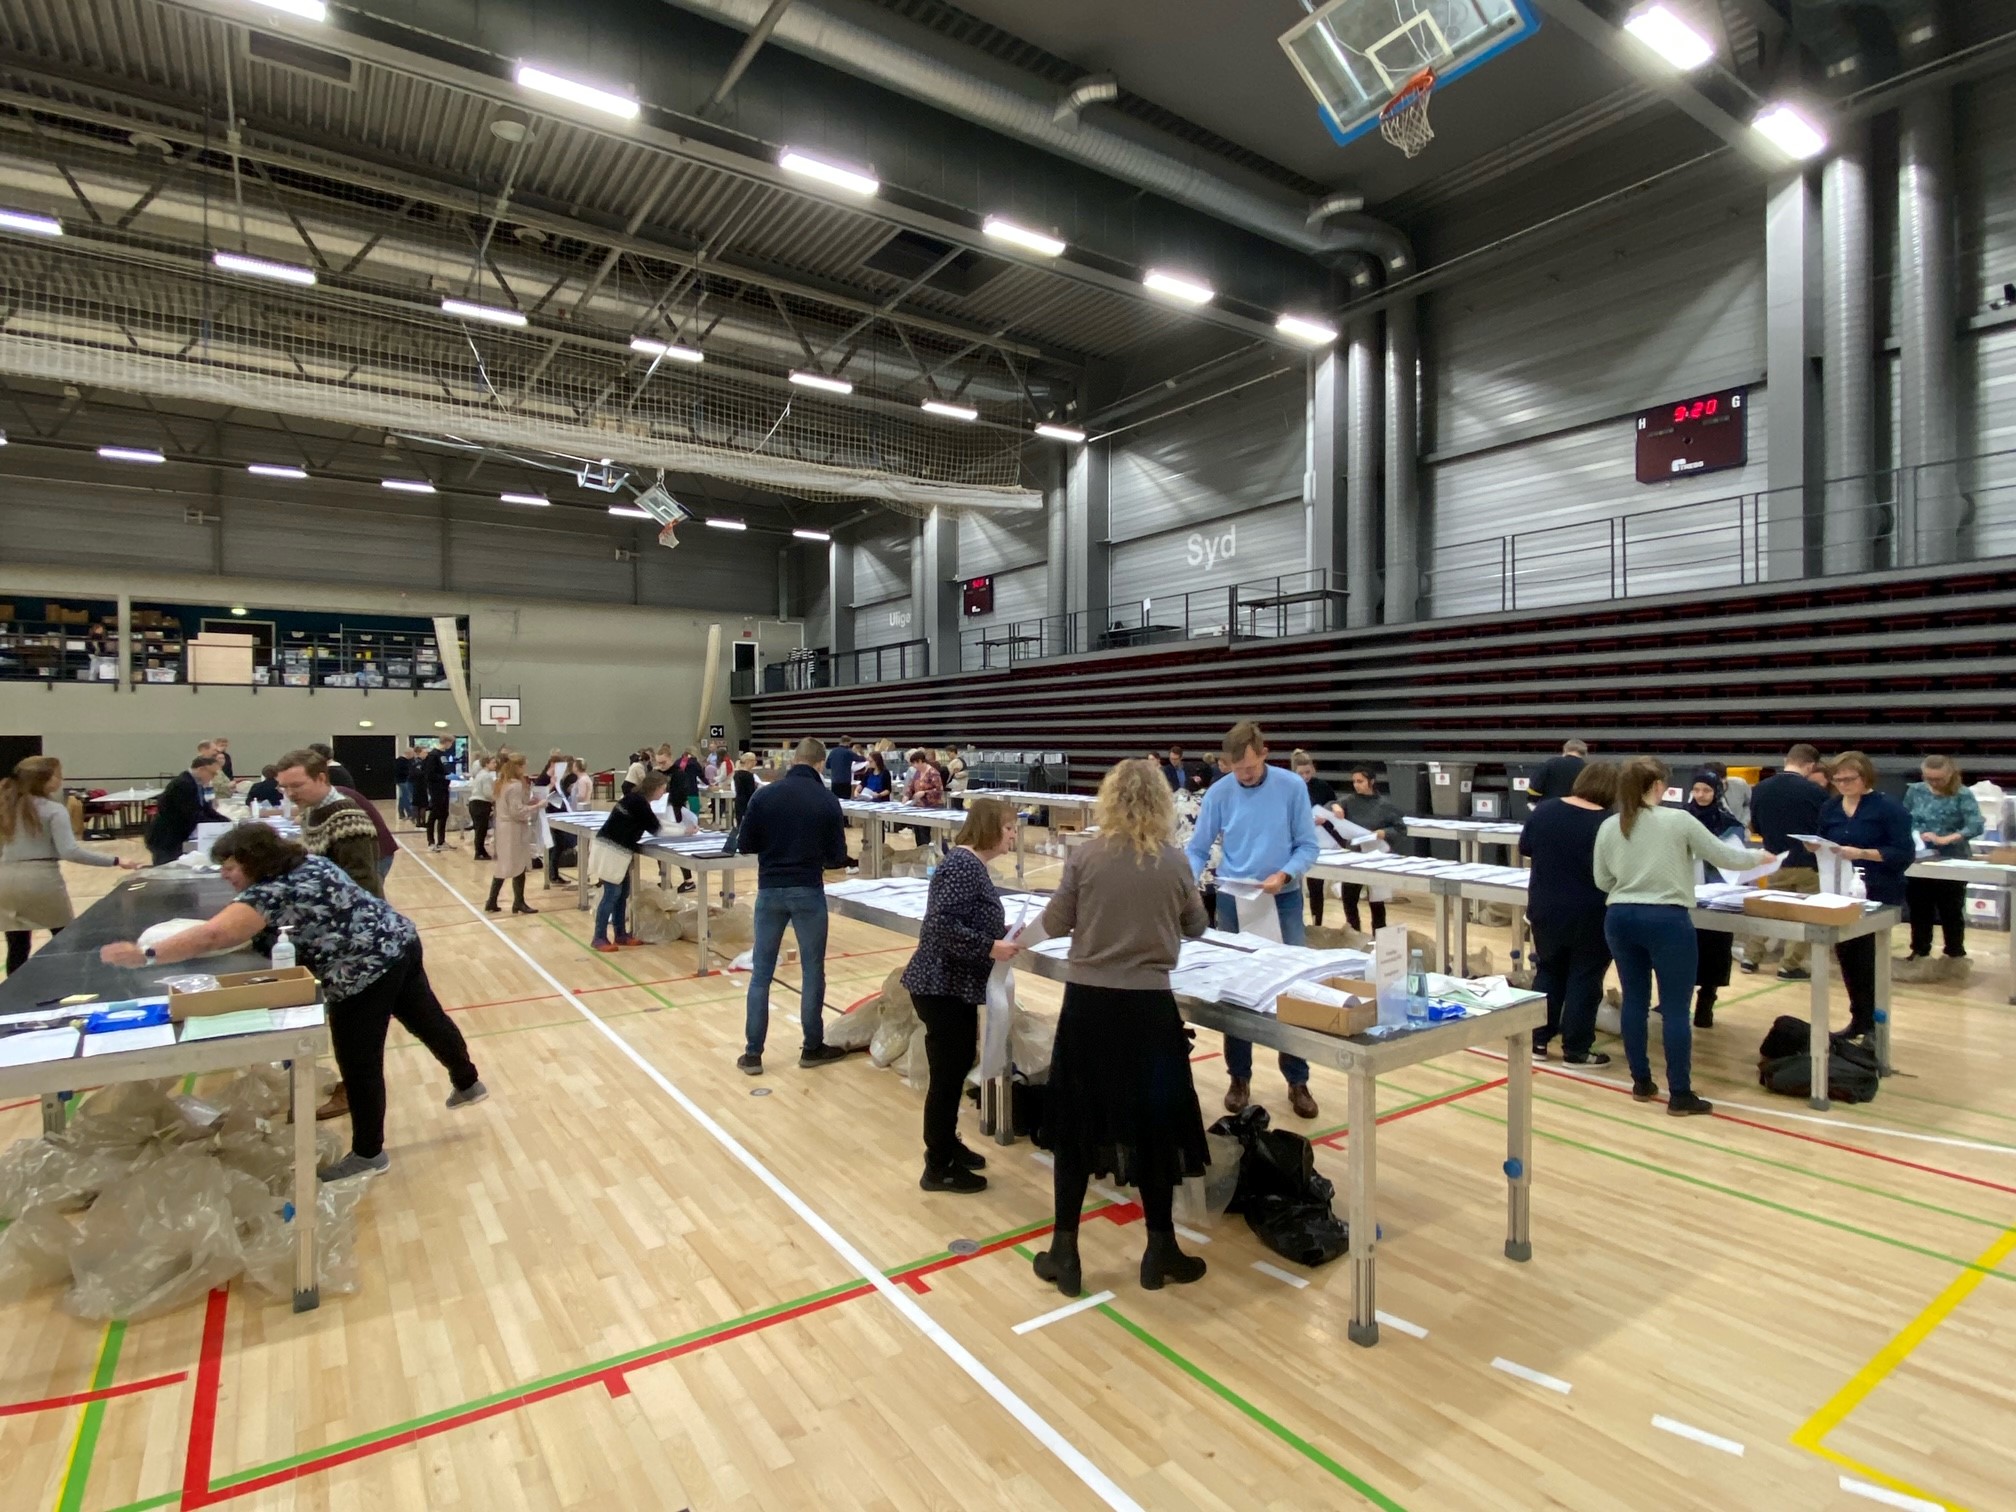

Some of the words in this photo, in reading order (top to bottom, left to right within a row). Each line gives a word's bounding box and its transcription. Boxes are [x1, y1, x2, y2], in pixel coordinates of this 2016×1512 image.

[1731, 395, 1741, 408] G
[1674, 399, 1718, 423] 9:20
[1638, 417, 1647, 430] H
[1187, 524, 1236, 571] Syd
[711, 727, 723, 736] C1
